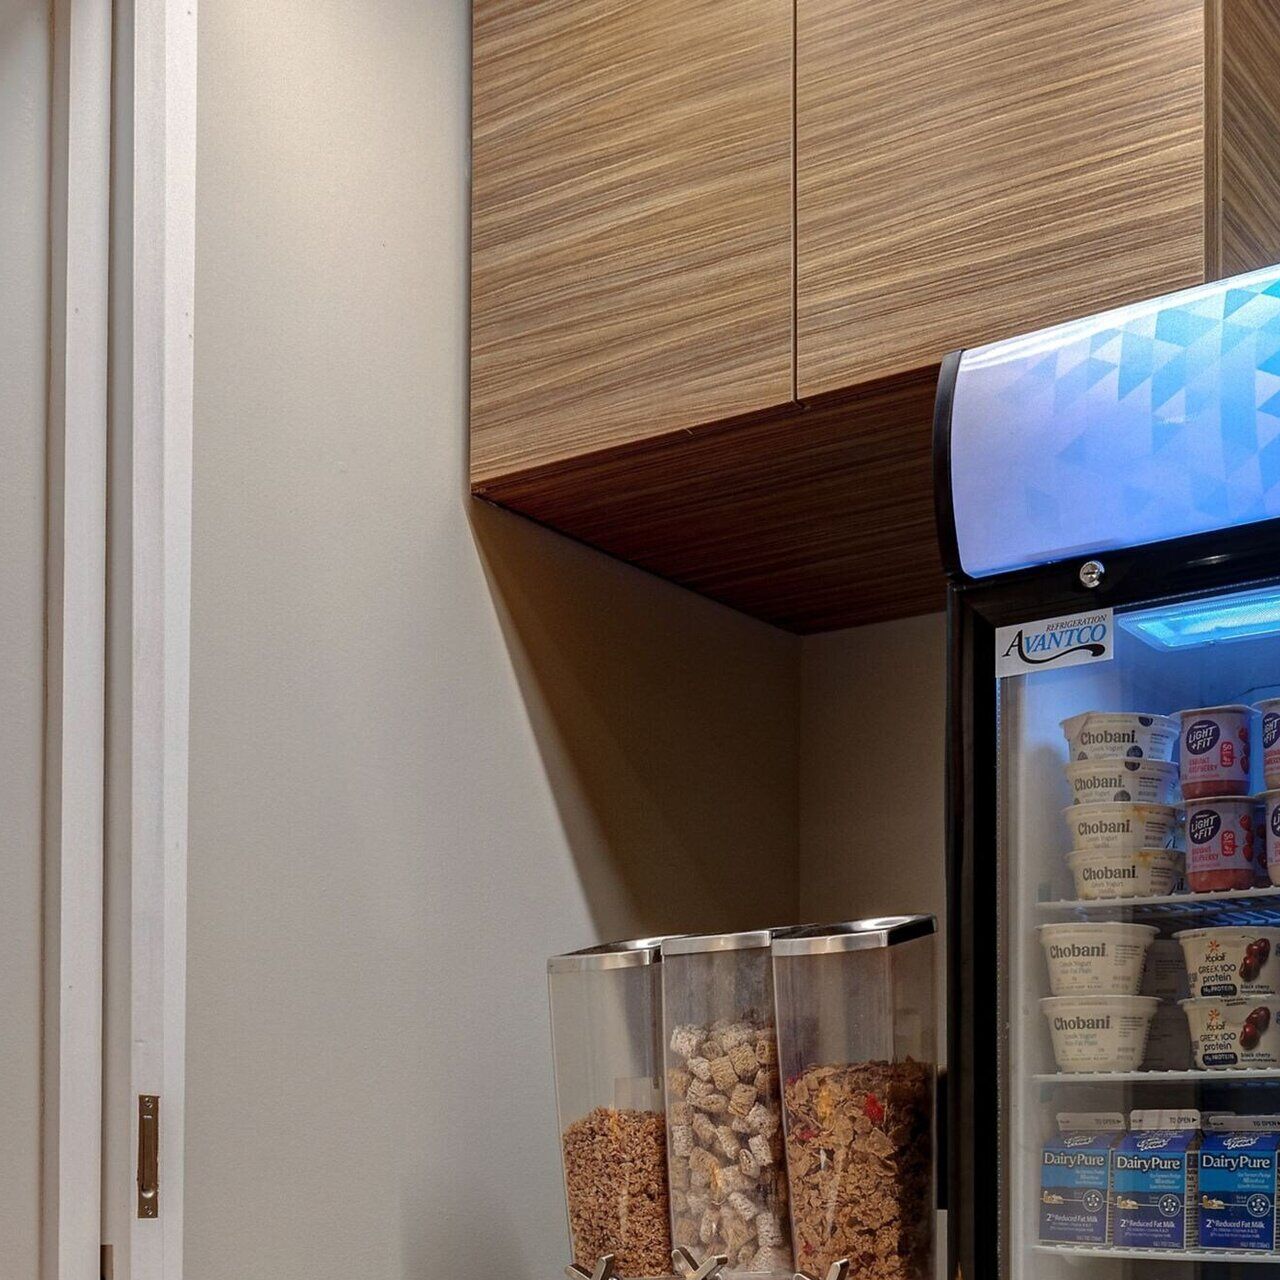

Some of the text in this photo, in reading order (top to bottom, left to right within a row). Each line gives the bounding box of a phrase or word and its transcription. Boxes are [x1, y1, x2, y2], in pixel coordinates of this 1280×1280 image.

[1046, 614, 1107, 632] REFRIGERATION
[1002, 623, 1107, 662] AVANTCO
[1202, 973, 1232, 984] protein
[1203, 1041, 1232, 1052] protein
[1044, 1152, 1105, 1167] DairyPure
[1116, 1156, 1181, 1172] DairyPure
[1202, 1155, 1271, 1171] DairyPure
[1055, 1214, 1077, 1223] Reduced
[1077, 1215, 1086, 1223] Fat
[1129, 1219, 1153, 1227] Reduced
[1163, 1220, 1175, 1228] Milk
[1216, 1219, 1240, 1228] Reduced
[1241, 1220, 1251, 1228] Fat
